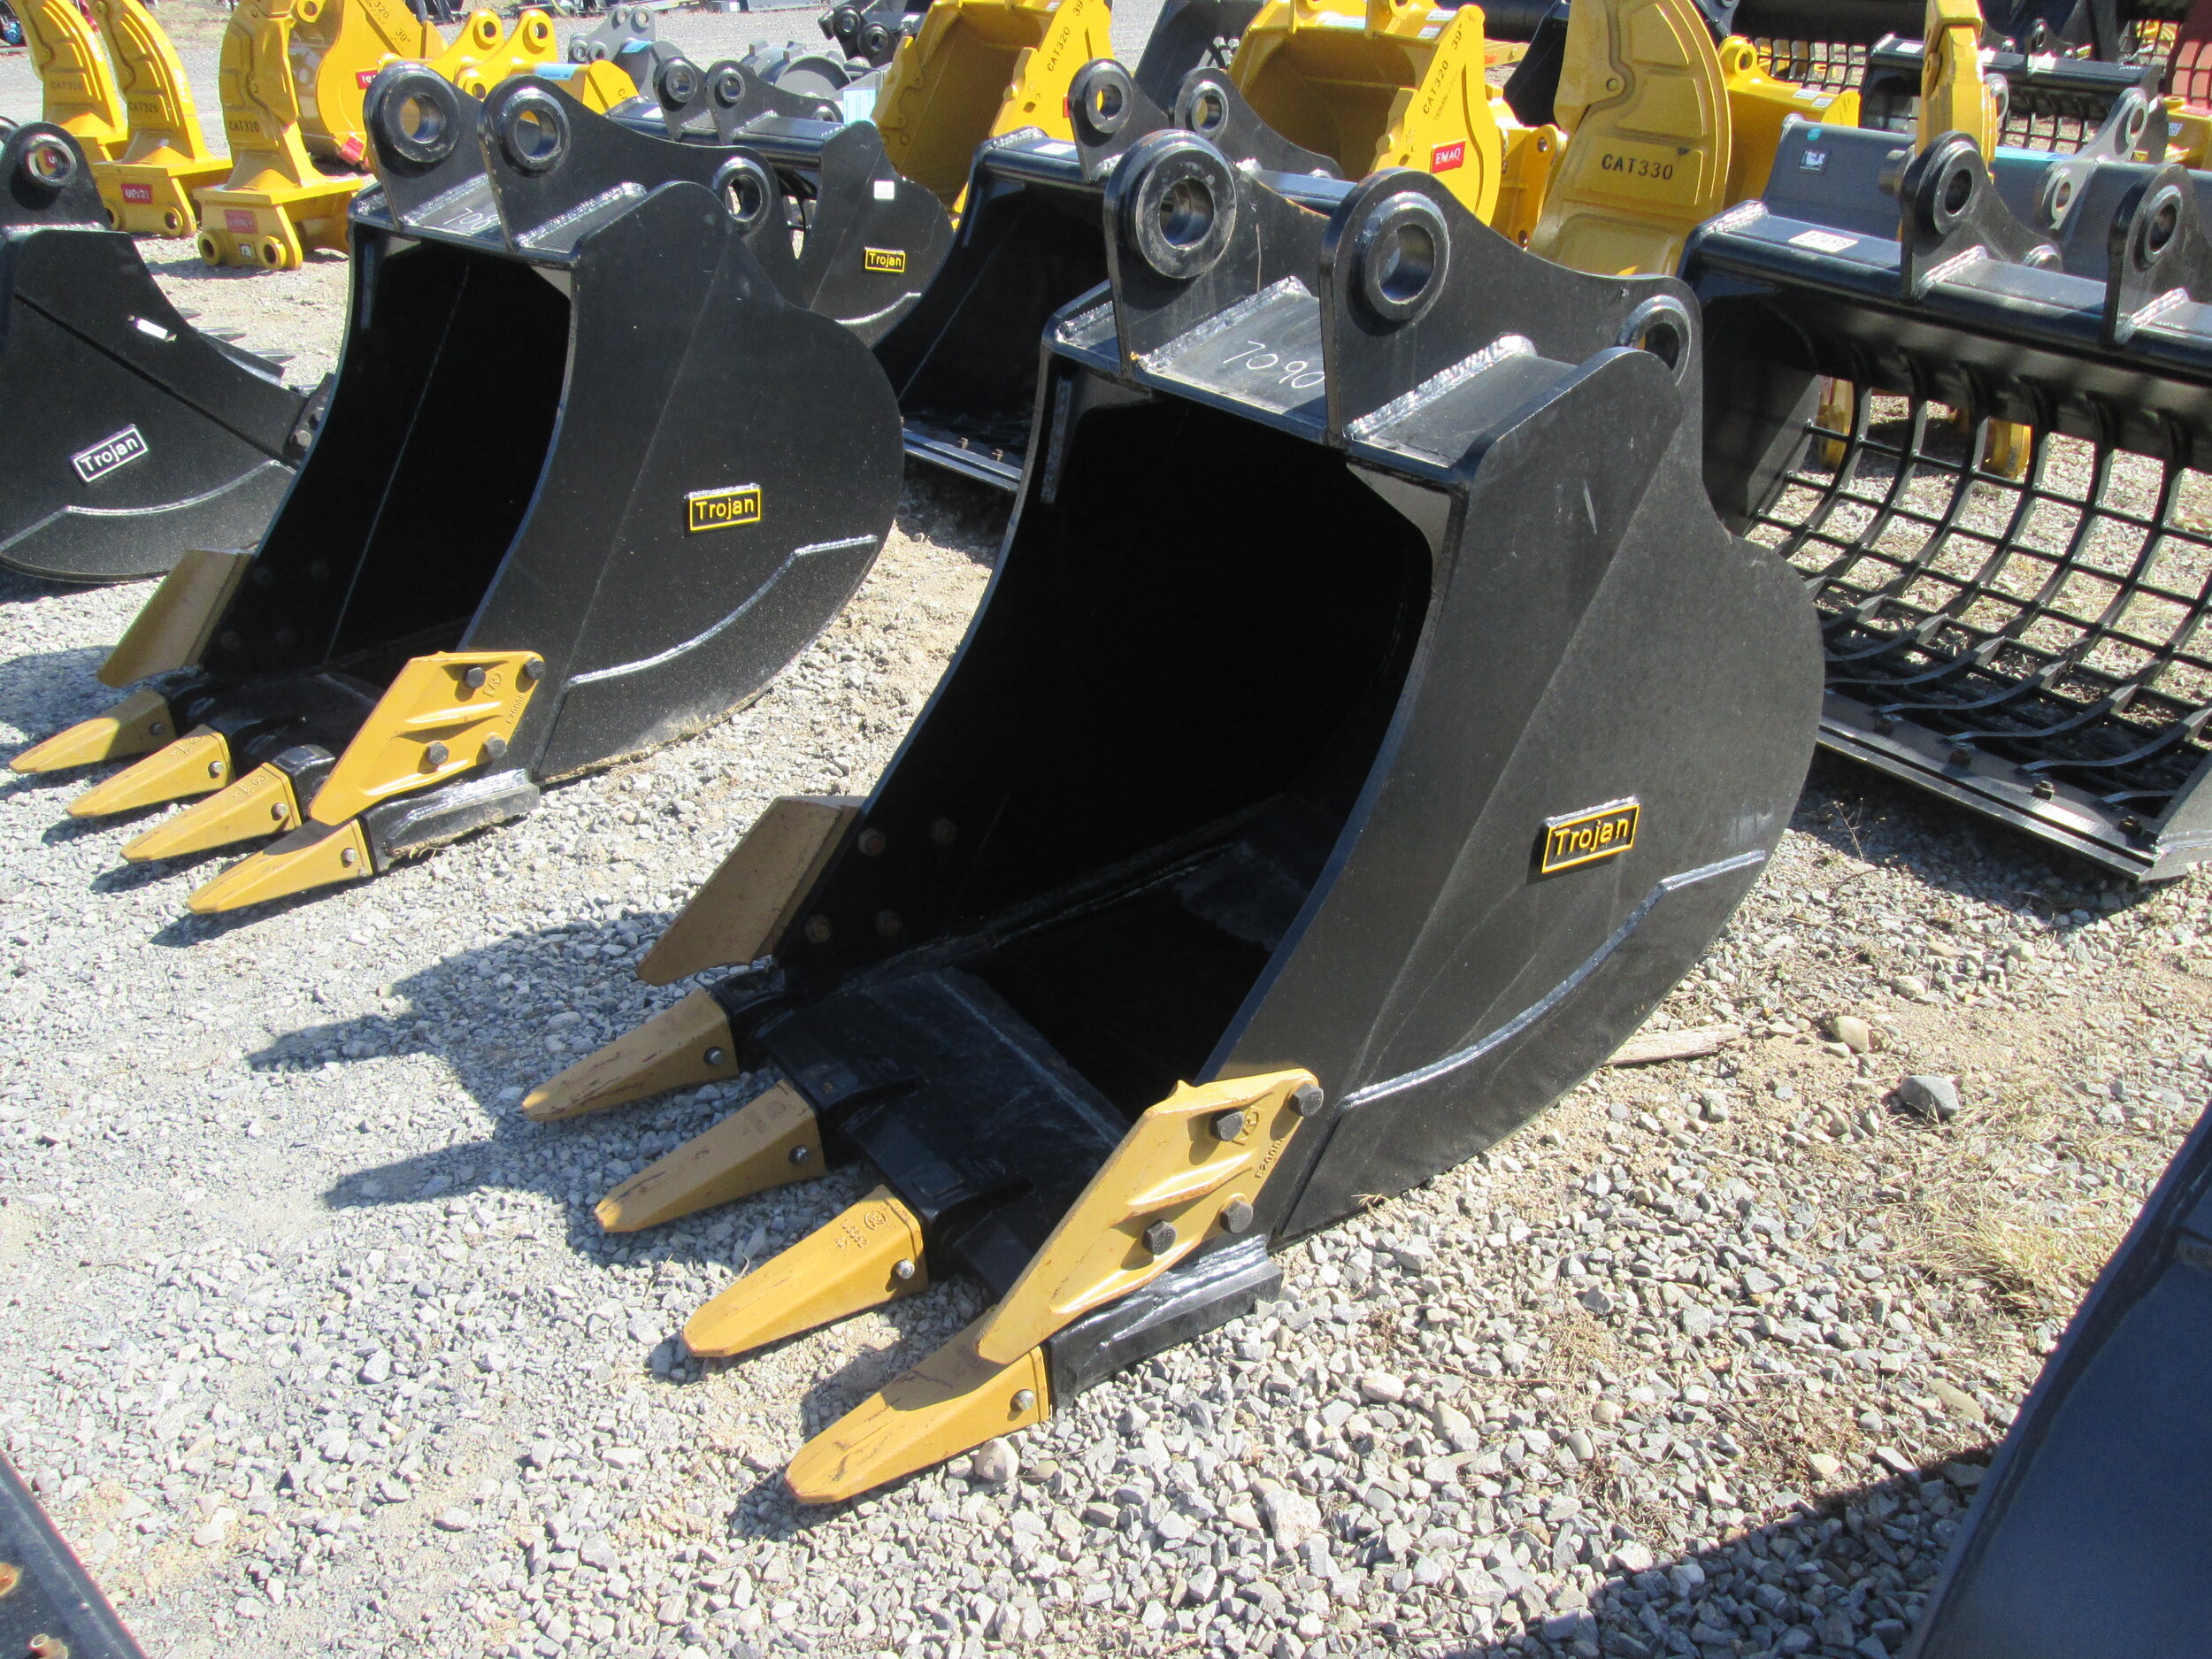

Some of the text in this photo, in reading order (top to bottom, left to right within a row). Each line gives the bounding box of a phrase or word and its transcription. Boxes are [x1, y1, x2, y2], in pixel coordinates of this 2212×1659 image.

[1047, 27, 1071, 72] CAT320
[1422, 60, 1449, 115] CAT320
[227, 119, 260, 134] CAT320
[1434, 147, 1461, 165] EMAQ
[1601, 153, 1673, 180] CAT330
[869, 252, 902, 268] Trojan
[1222, 340, 1325, 388] 7090
[80, 437, 139, 472] Trojan
[695, 496, 754, 520] Trojan
[1554, 818, 1629, 856] Trojan
